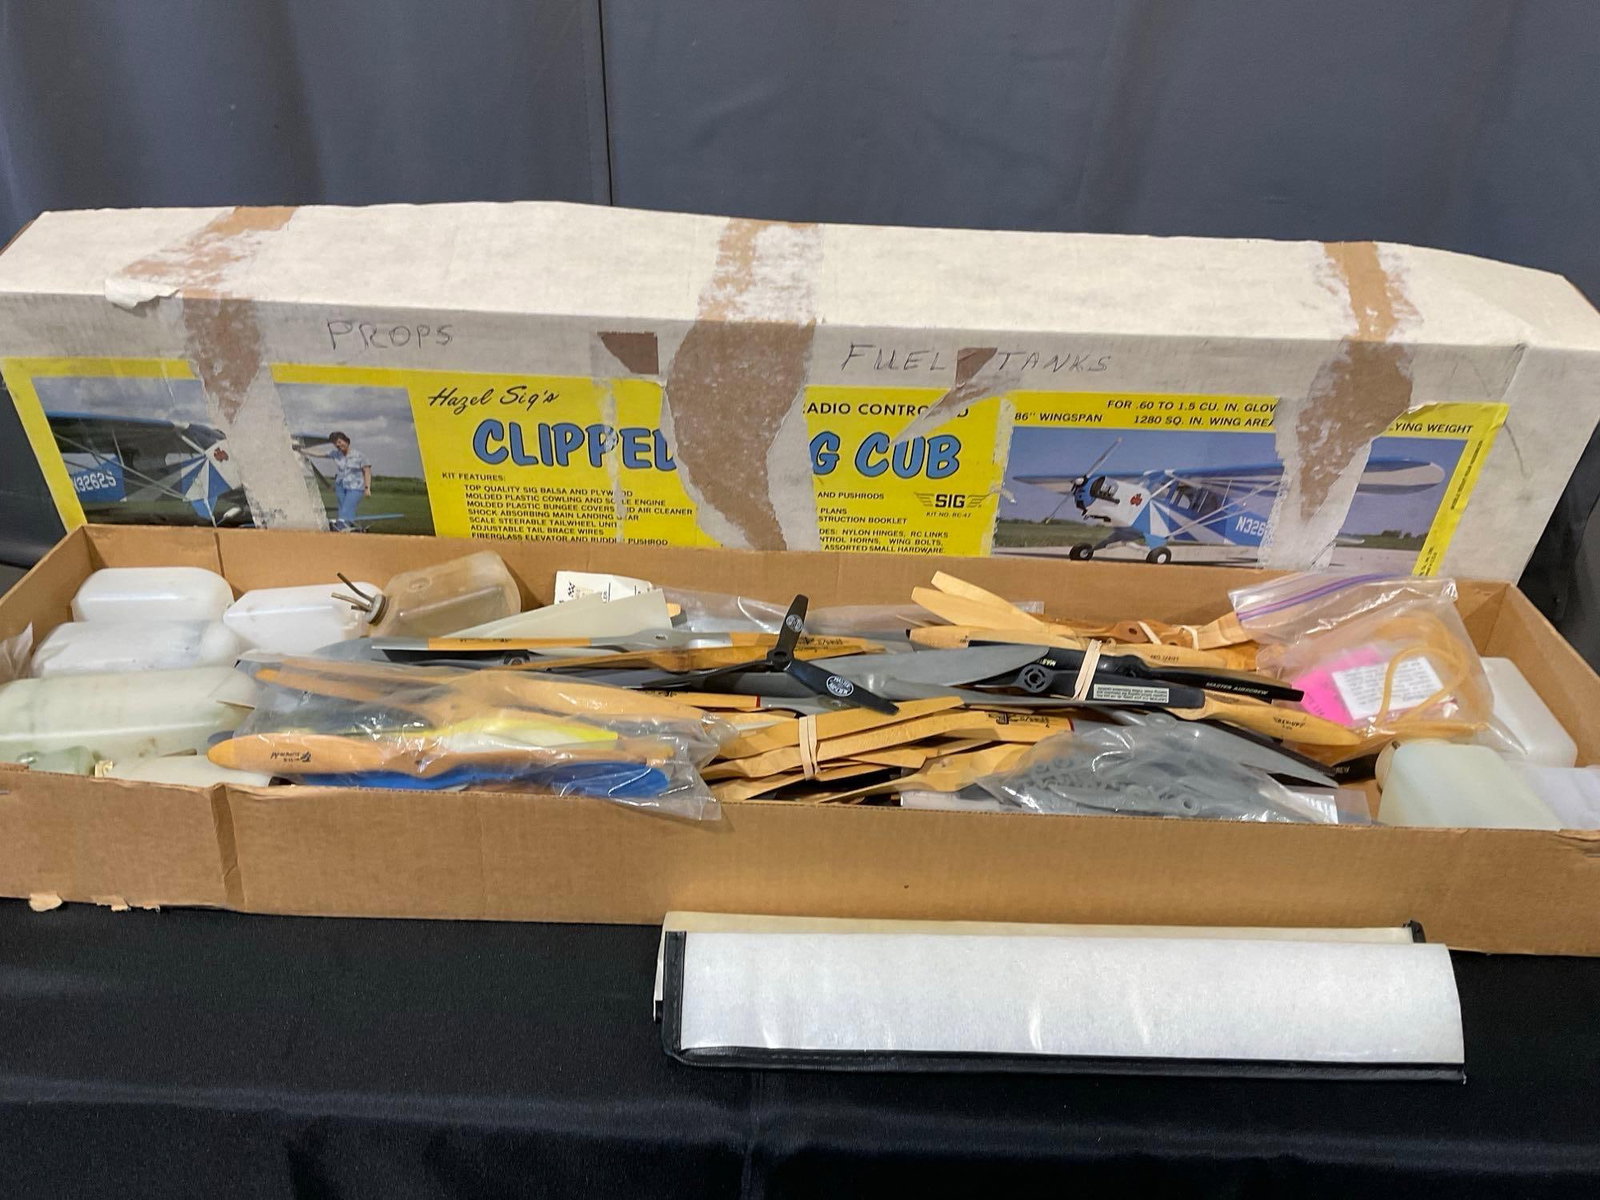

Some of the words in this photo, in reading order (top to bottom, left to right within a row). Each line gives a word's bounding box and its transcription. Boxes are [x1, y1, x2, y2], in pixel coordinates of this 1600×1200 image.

[326, 319, 453, 350] PROPS
[841, 344, 947, 372] FUEL
[997, 351, 1111, 373] TANKS
[427, 387, 492, 415] Hazel
[1107, 400, 1132, 409] FOR
[1136, 401, 1154, 410] .60
[1158, 401, 1174, 410] TO
[1179, 402, 1195, 411] 1.5
[1199, 402, 1219, 412] CU.
[1224, 403, 1239, 412] IN.
[803, 402, 851, 415] ADIO
[858, 403, 969, 418] CONTRD
[1039, 412, 1103, 423] WINGSPAN
[1134, 415, 1162, 425] 1280
[1165, 416, 1184, 426] SQ.
[1189, 416, 1204, 425] IN.
[1209, 417, 1241, 427] WING
[1388, 422, 1423, 432] YING
[1427, 424, 1474, 434] WEIGHT
[854, 431, 961, 480] CUB
[458, 473, 505, 481] FEATURES:
[484, 485, 520, 493] QUALITY
[540, 487, 567, 495] BALSA
[590, 489, 633, 497] PLYWD
[817, 491, 836, 499] AND
[838, 492, 884, 500] PUSHRODS
[505, 494, 540, 502] PLASTIC
[542, 495, 582, 504] COWLING
[584, 496, 602, 504] AND
[605, 497, 632, 505] SCLE
[935, 493, 965, 508] SIG
[467, 500, 504, 508] MOLDED
[543, 503, 578, 511] BUNGEE
[581, 504, 615, 512] COVERS
[654, 507, 693, 515] CLEANER
[820, 507, 847, 515] PLANS
[468, 508, 497, 516] SHOCK
[500, 510, 550, 518] ABSORBING
[576, 512, 614, 520] LANDING
[469, 516, 495, 524] SCALE
[549, 519, 596, 527] TAILWHEEL
[818, 516, 867, 524] STRUCTION
[868, 517, 907, 525] BOOKLET
[1236, 515, 1266, 537] N326
[470, 524, 523, 532] ADJUSTABLE
[872, 529, 906, 538] HINGES,
[471, 532, 522, 540] FIBERGLASS
[525, 534, 567, 542] ELEVATOR
[628, 538, 668, 546] PUSHROD
[824, 544, 868, 552] ASSORTED
